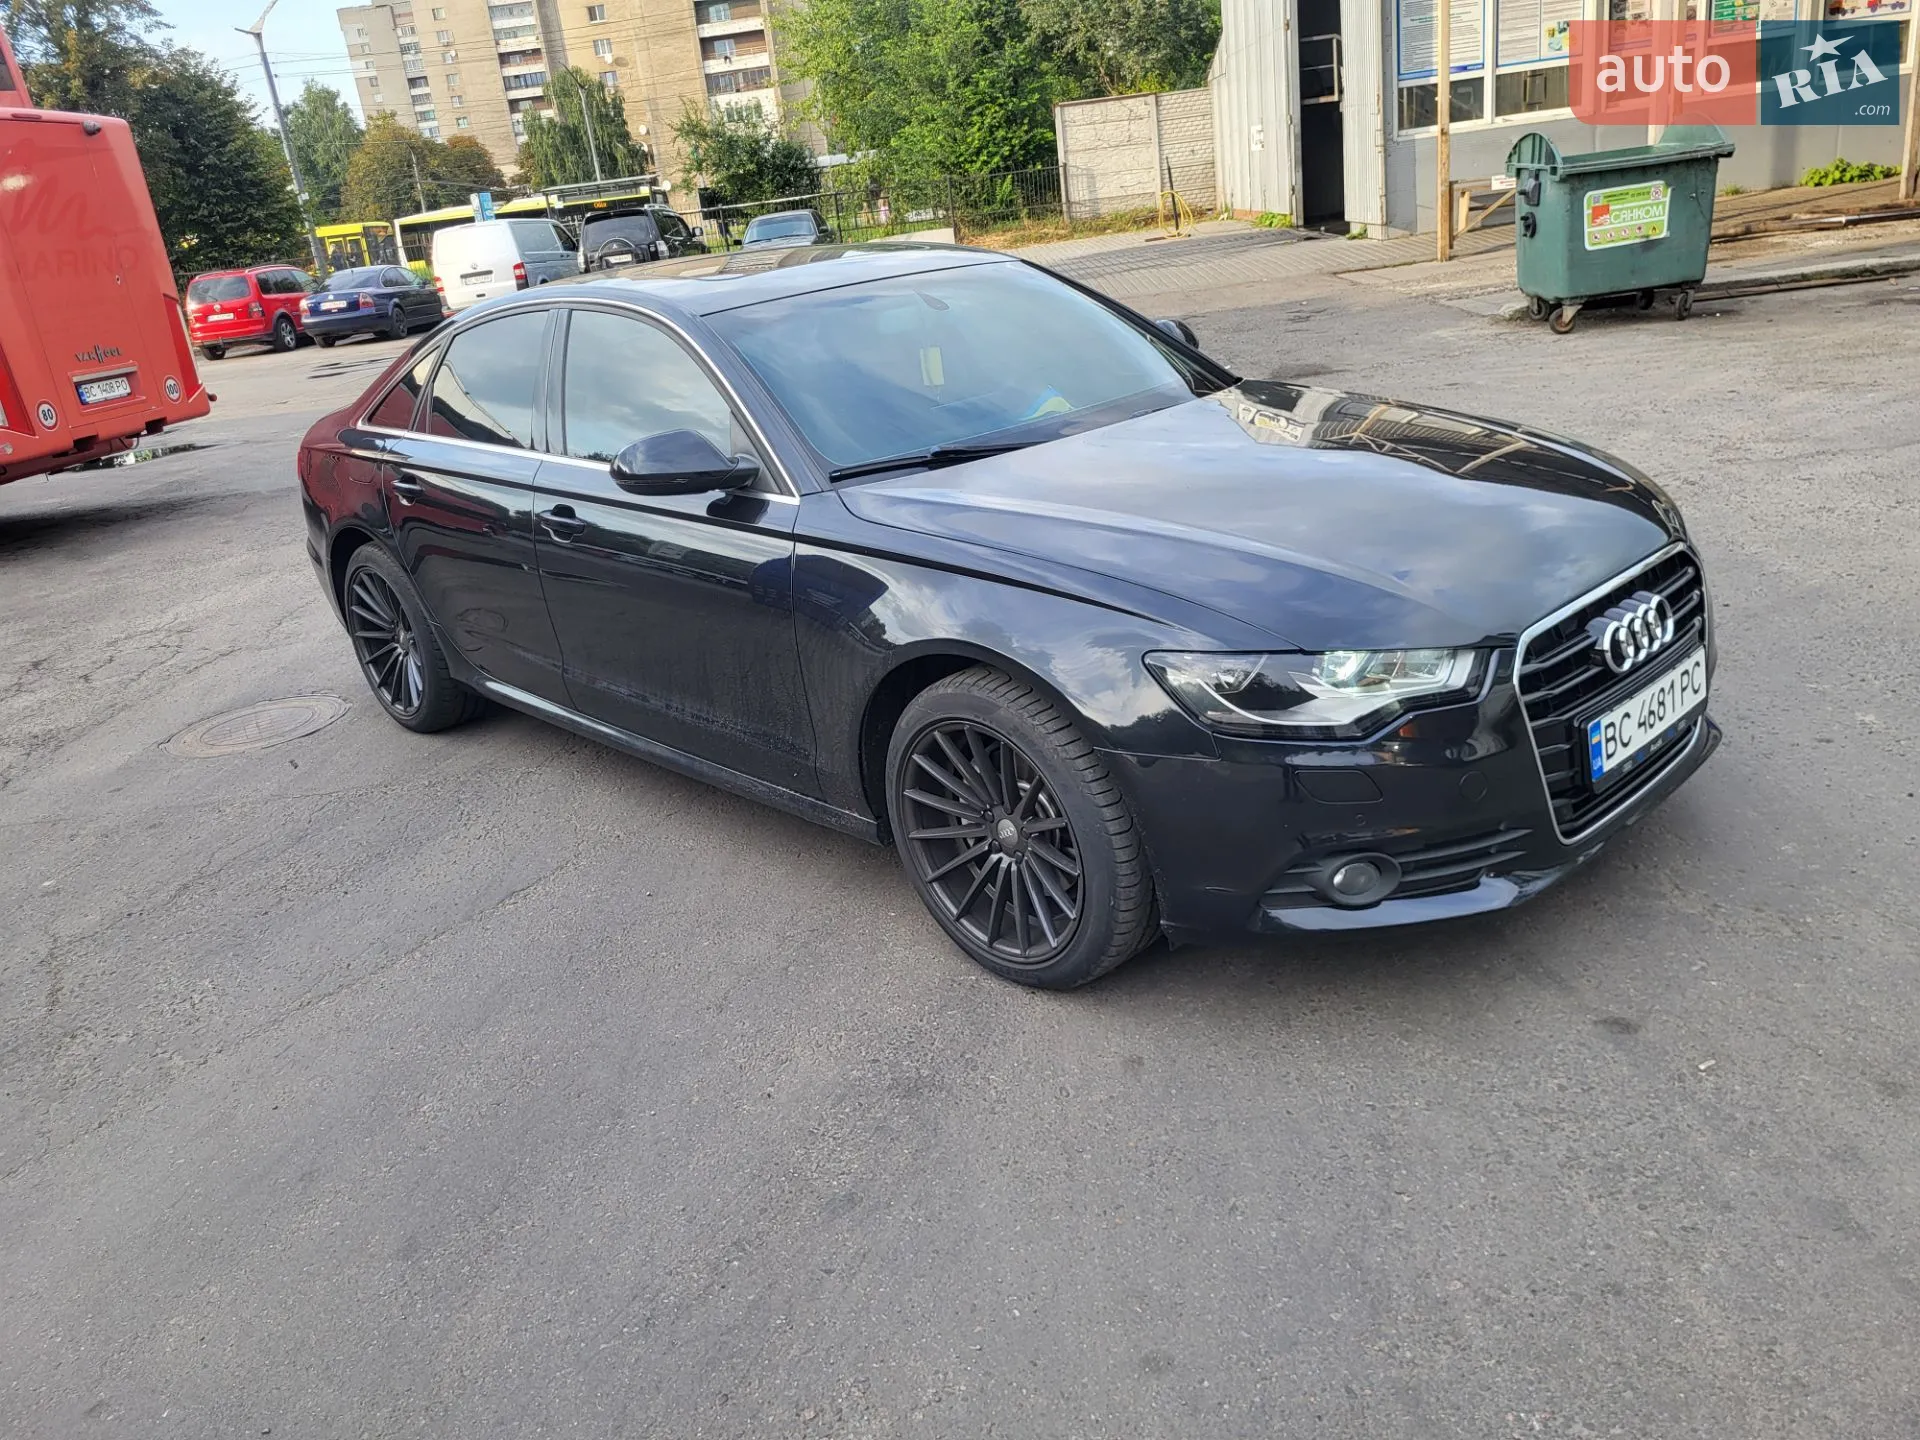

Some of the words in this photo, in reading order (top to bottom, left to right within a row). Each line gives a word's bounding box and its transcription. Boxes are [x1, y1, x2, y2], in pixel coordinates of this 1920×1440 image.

[83, 385, 97, 399] BC
[166, 382, 179, 396] 100
[42, 408, 54, 422] 80
[1604, 711, 1632, 760] BC
[1637, 679, 1675, 734] 4681
[1680, 660, 1702, 706] PC
